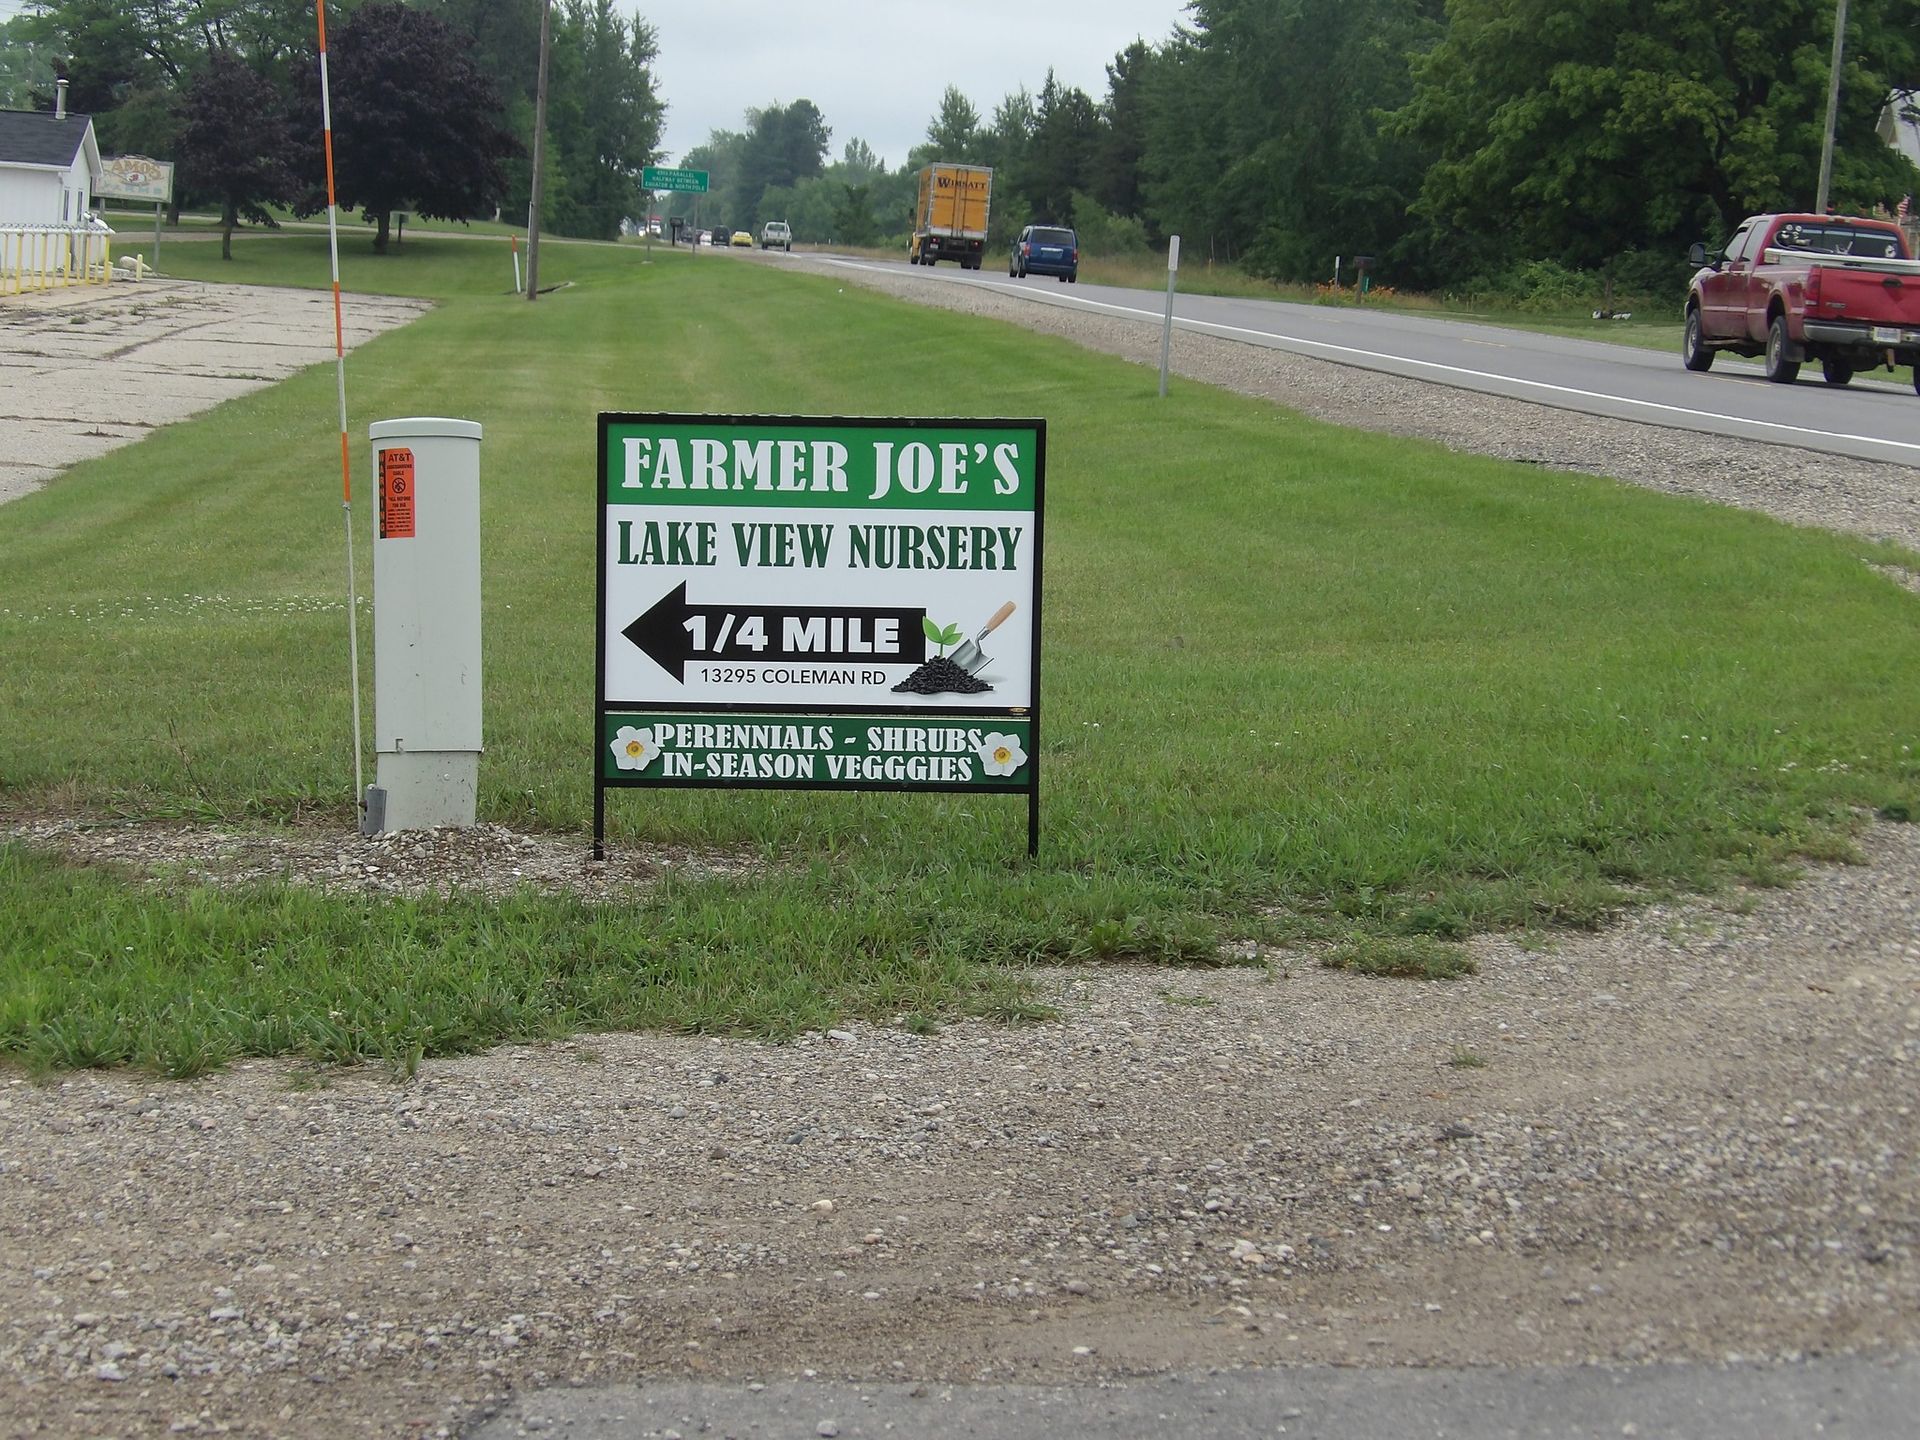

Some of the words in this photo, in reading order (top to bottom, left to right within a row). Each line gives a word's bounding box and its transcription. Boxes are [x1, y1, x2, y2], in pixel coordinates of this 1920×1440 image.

[938, 176, 986, 189] WIMSATT
[388, 453, 411, 462] AT&T
[621, 437, 849, 492] FARMER
[868, 441, 1020, 500] JOE'S
[617, 520, 717, 566] LAKE
[731, 522, 834, 568] VIEW
[848, 525, 1023, 570] NURSERY
[682, 613, 769, 654] 1/4
[782, 616, 900, 654] MILE
[701, 668, 756, 684] 13295
[762, 669, 856, 685] COLEMAN
[861, 671, 886, 685] RD
[653, 723, 834, 751] PERENNIALS
[867, 726, 984, 753] SHRUBS
[662, 752, 815, 779] IN-SEASON
[825, 755, 973, 782] VEGGGIES
